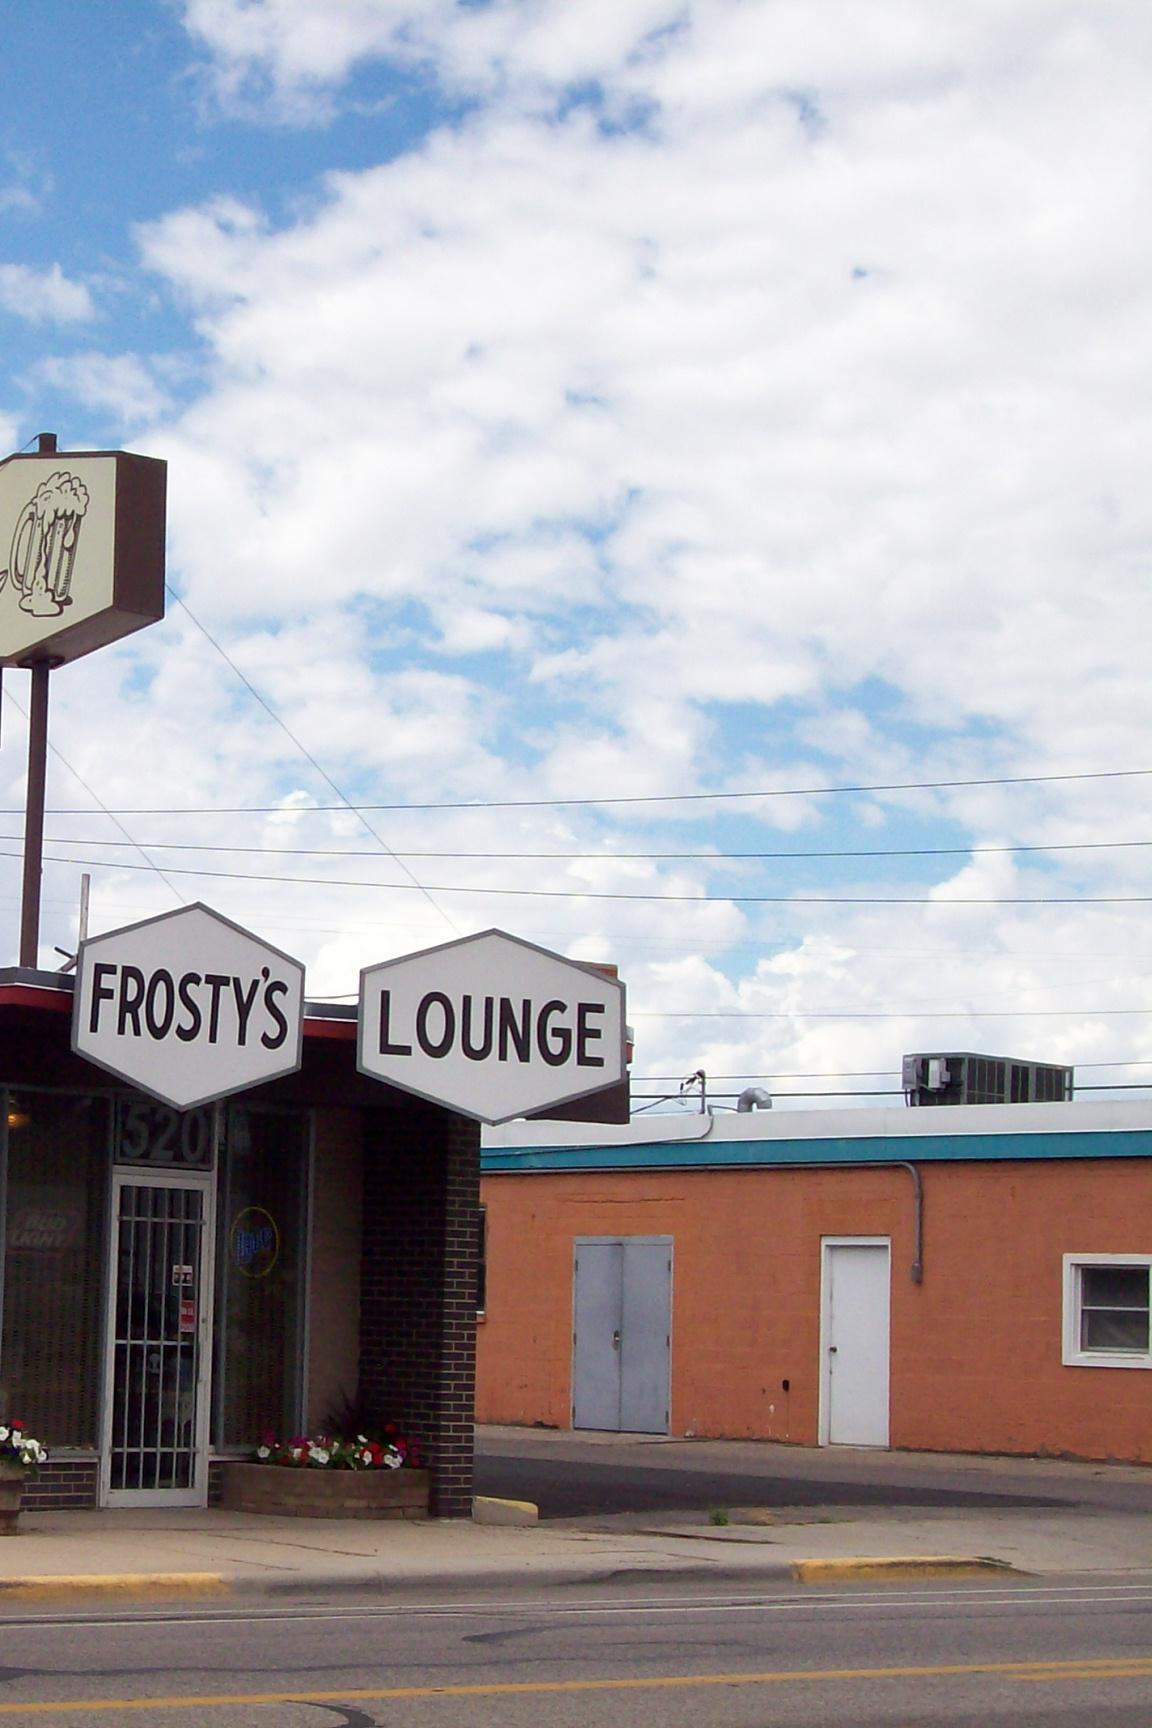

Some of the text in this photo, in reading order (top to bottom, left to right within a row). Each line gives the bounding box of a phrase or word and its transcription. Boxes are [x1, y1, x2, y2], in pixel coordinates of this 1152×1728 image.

[89, 962, 289, 1050] FROSTY'S
[379, 989, 606, 1067] LOUNGE
[120, 1102, 207, 1162] 520
